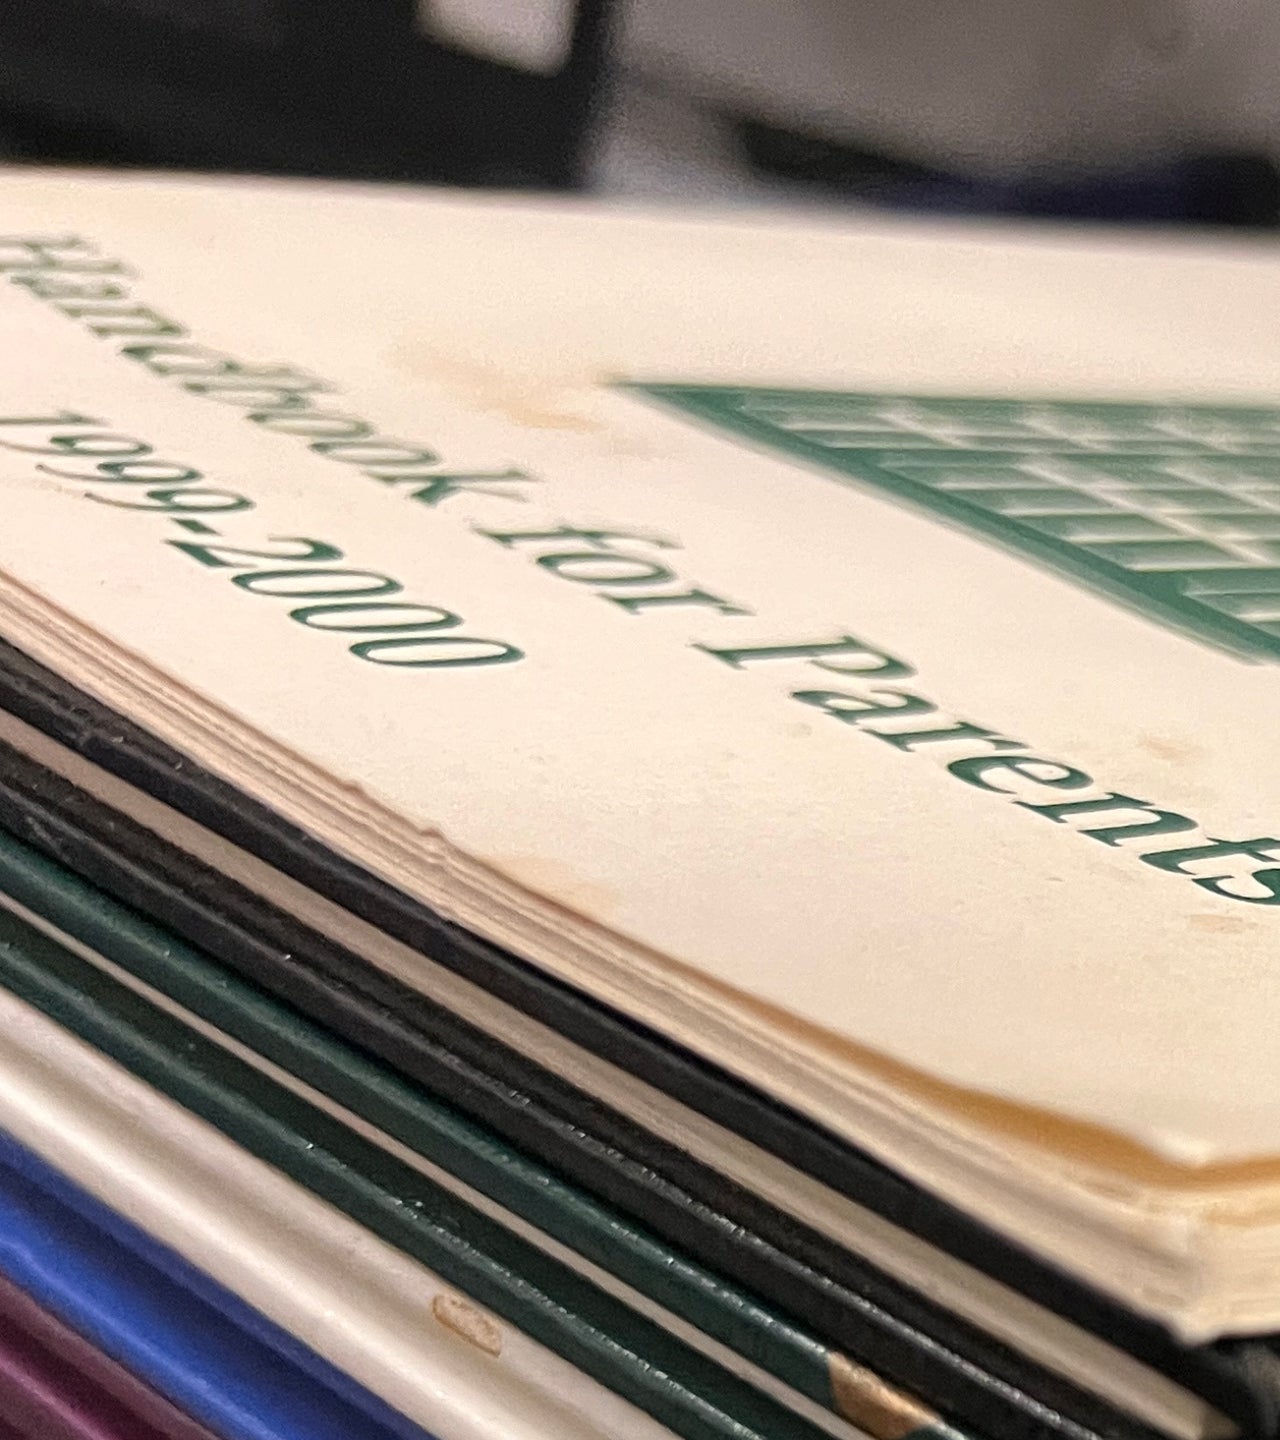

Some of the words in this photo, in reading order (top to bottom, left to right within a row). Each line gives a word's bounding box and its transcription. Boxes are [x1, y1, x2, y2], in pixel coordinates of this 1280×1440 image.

[0, 233, 537, 507] Handbook
[472, 523, 756, 616] for
[0, 408, 525, 668] 1999-2000
